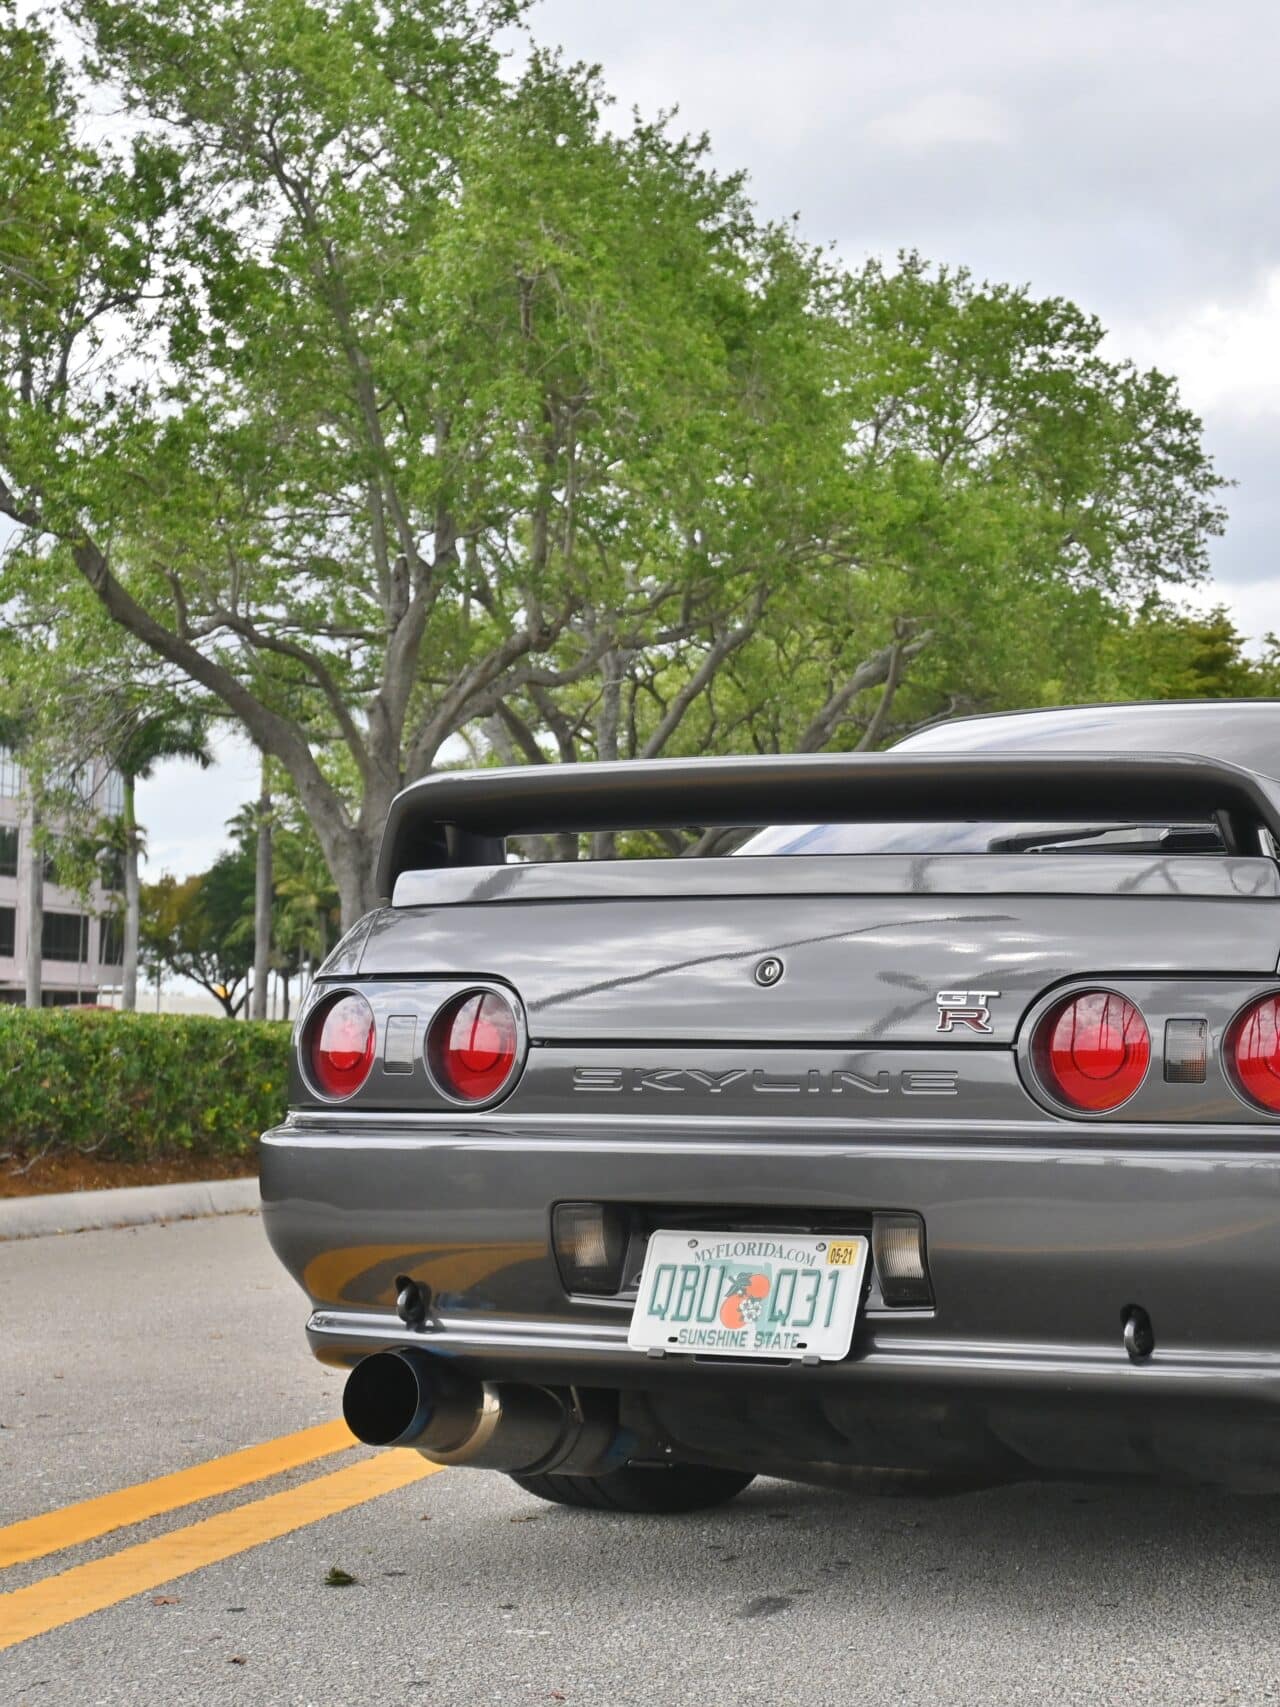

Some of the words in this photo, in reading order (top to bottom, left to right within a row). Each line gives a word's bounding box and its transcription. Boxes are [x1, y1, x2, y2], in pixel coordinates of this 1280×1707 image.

[936, 991, 1000, 1006] GT
[573, 1066, 959, 1096] SKYLINE
[694, 1241, 816, 1267] MYFLORIDA.COM
[829, 1247, 853, 1265] 05-21
[647, 1264, 727, 1323] QBU
[768, 1268, 840, 1328] Q31
[678, 1328, 748, 1347] SUNSHINE
[754, 1331, 800, 1349] STATE
